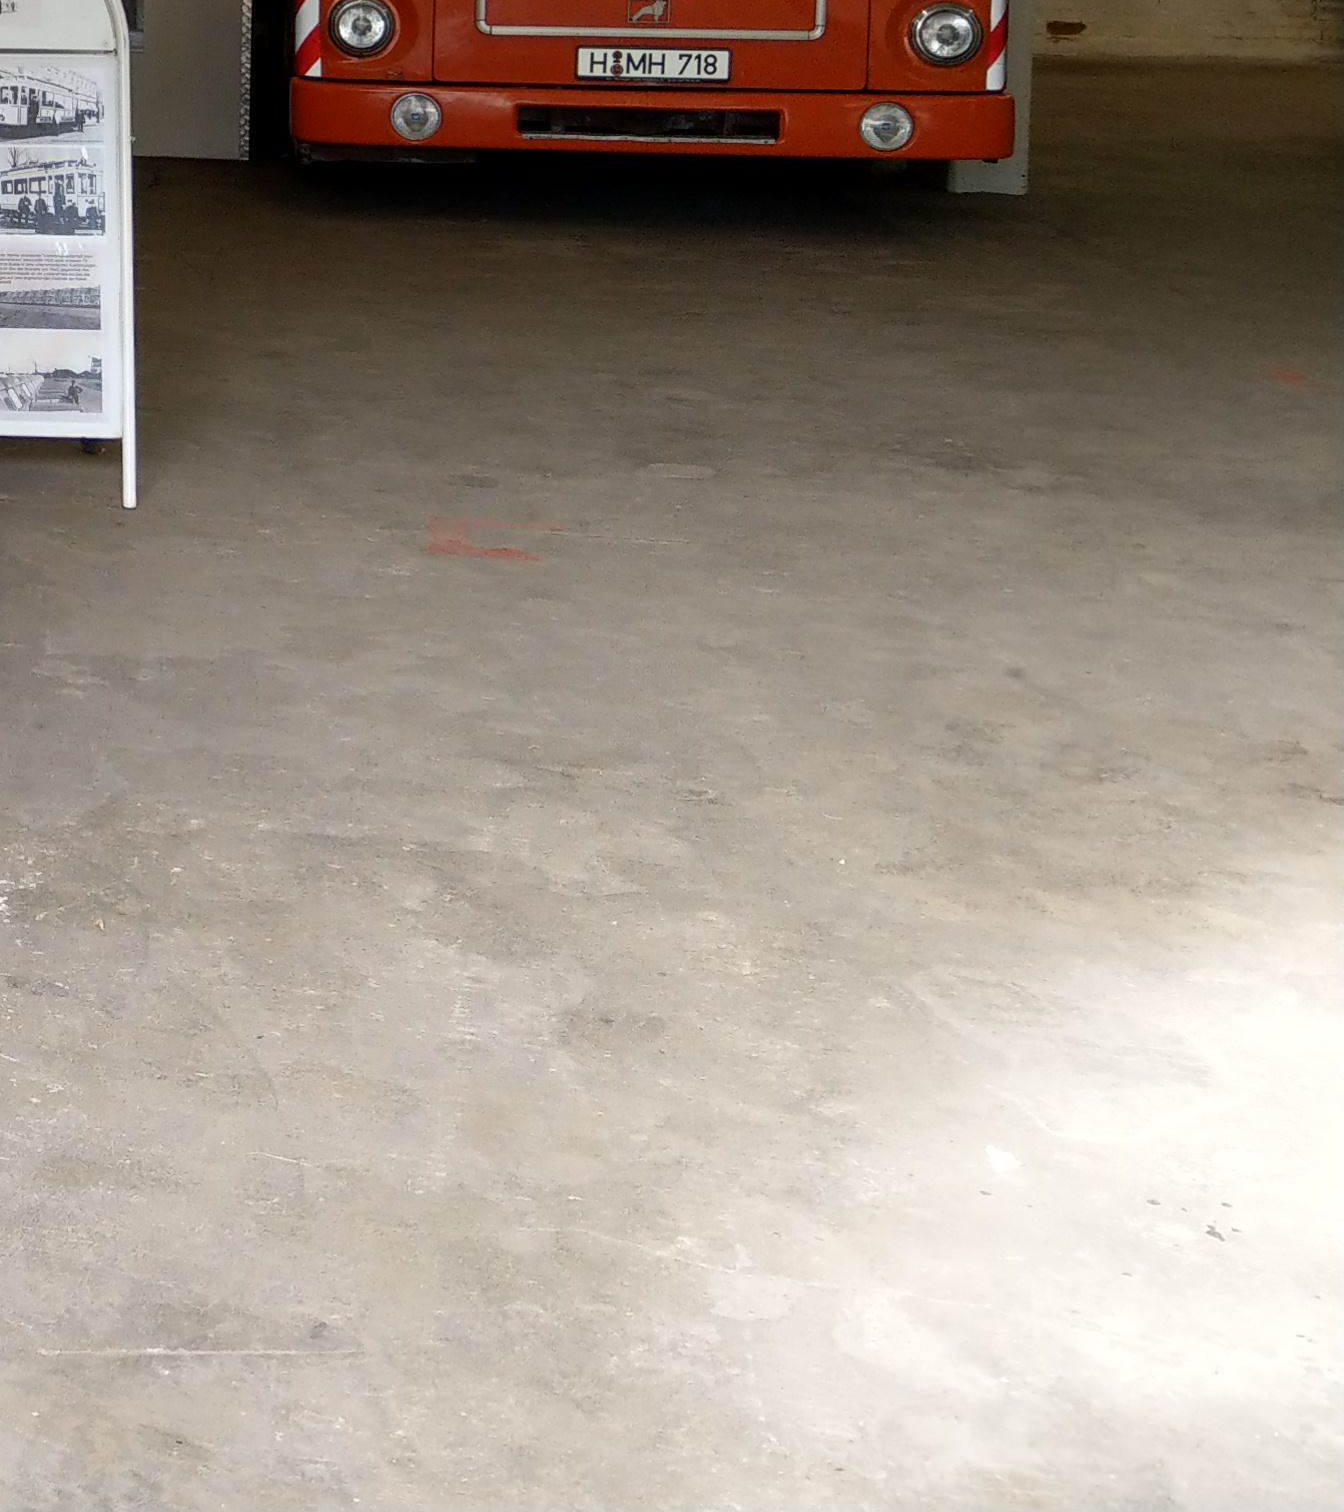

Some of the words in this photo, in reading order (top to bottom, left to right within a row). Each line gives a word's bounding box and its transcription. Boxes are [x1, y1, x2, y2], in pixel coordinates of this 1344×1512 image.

[590, 52, 608, 74] H
[626, 53, 666, 75] MH
[678, 53, 718, 76] 718
